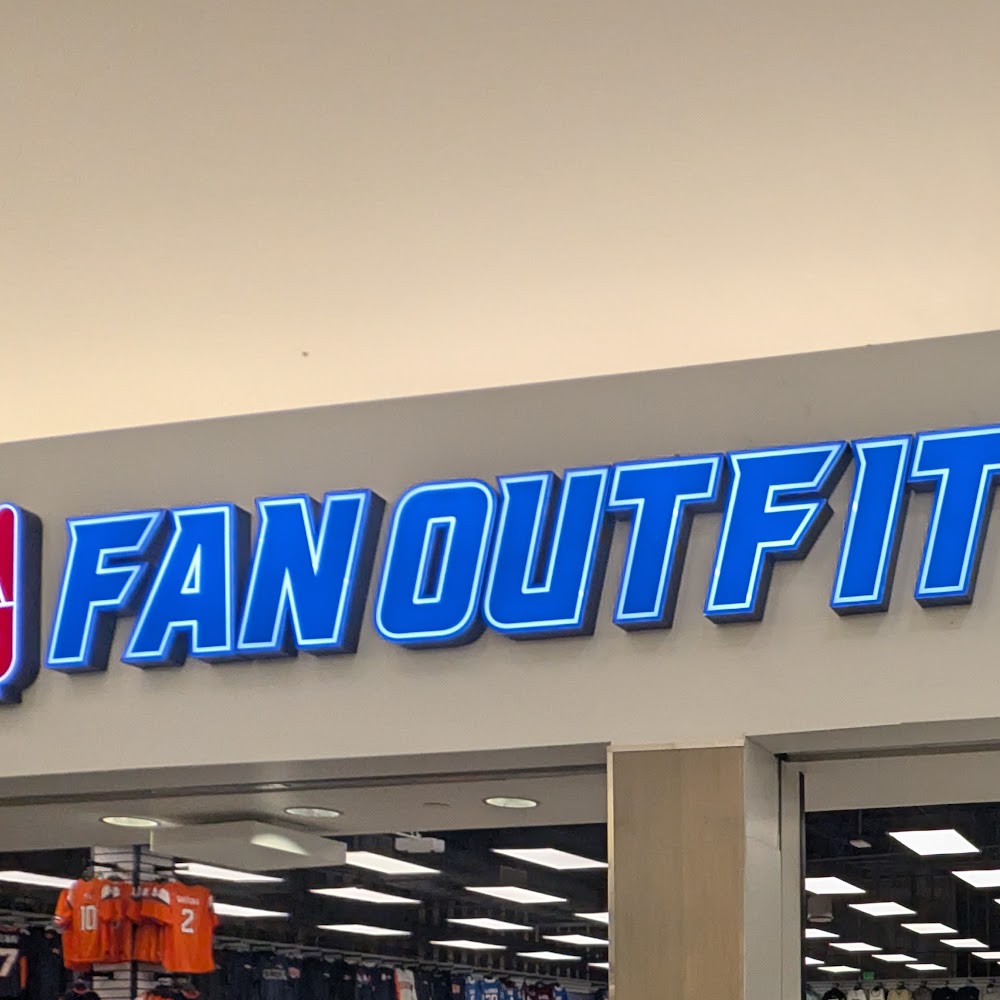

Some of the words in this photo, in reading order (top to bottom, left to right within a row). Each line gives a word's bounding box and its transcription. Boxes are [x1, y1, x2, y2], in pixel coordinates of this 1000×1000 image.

[45, 489, 378, 671] FAN
[80, 905, 97, 931] 10
[181, 908, 194, 934] 2
